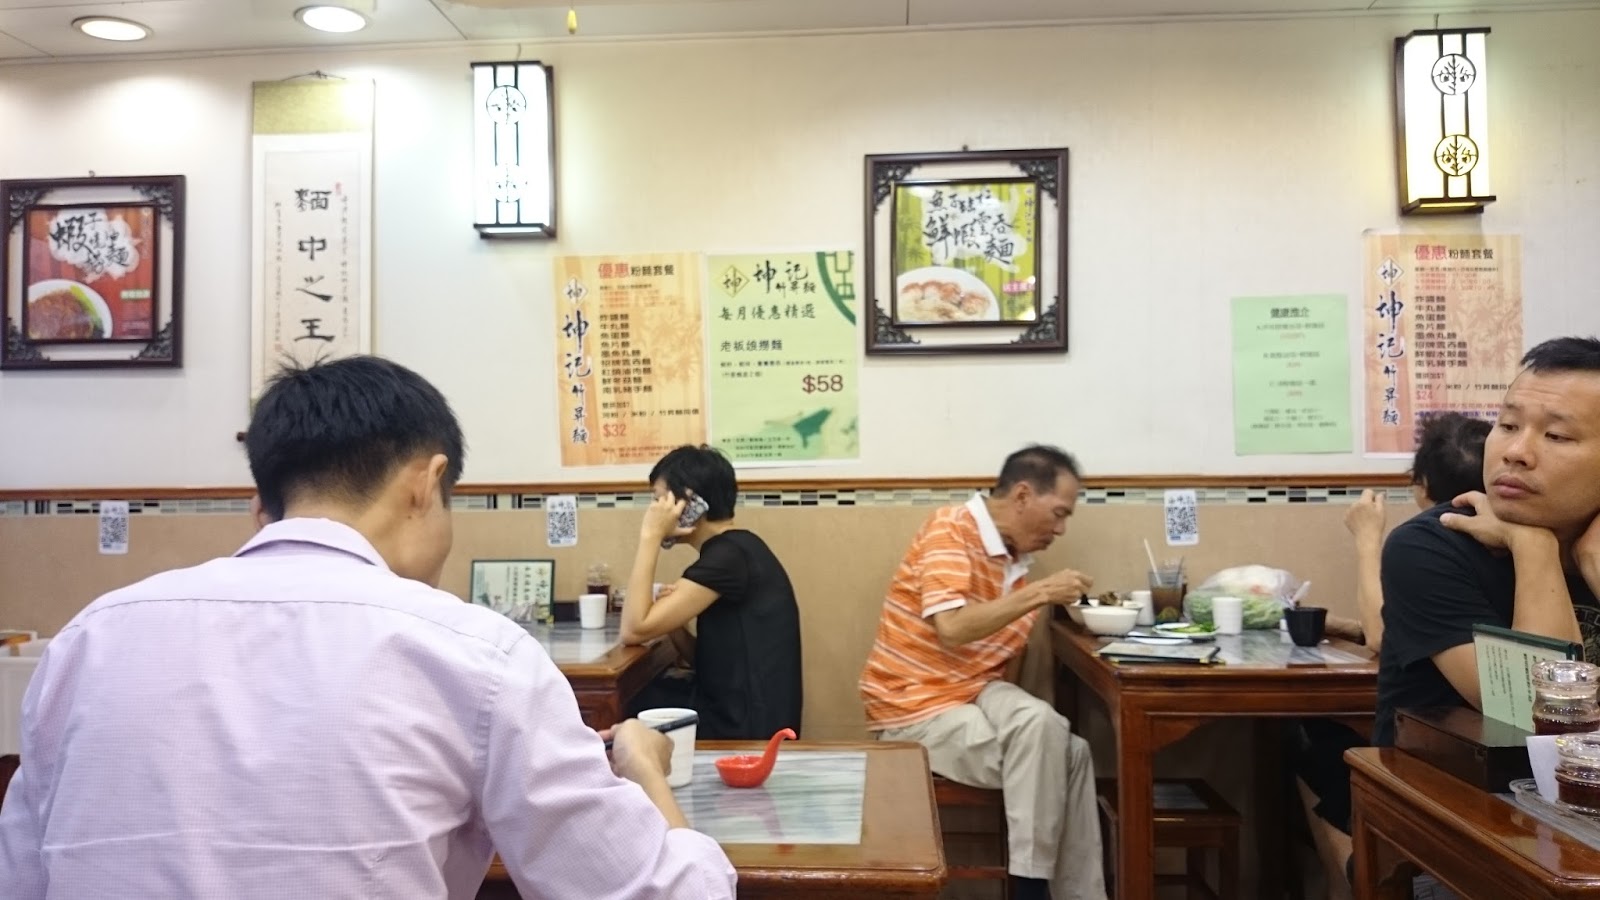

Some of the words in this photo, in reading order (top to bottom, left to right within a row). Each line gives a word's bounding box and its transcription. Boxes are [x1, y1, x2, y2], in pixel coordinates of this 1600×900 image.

[293, 188, 336, 343] 麵中之王
[802, 374, 844, 395] $58
[1416, 390, 1433, 401] $24
[603, 423, 627, 437] $32
